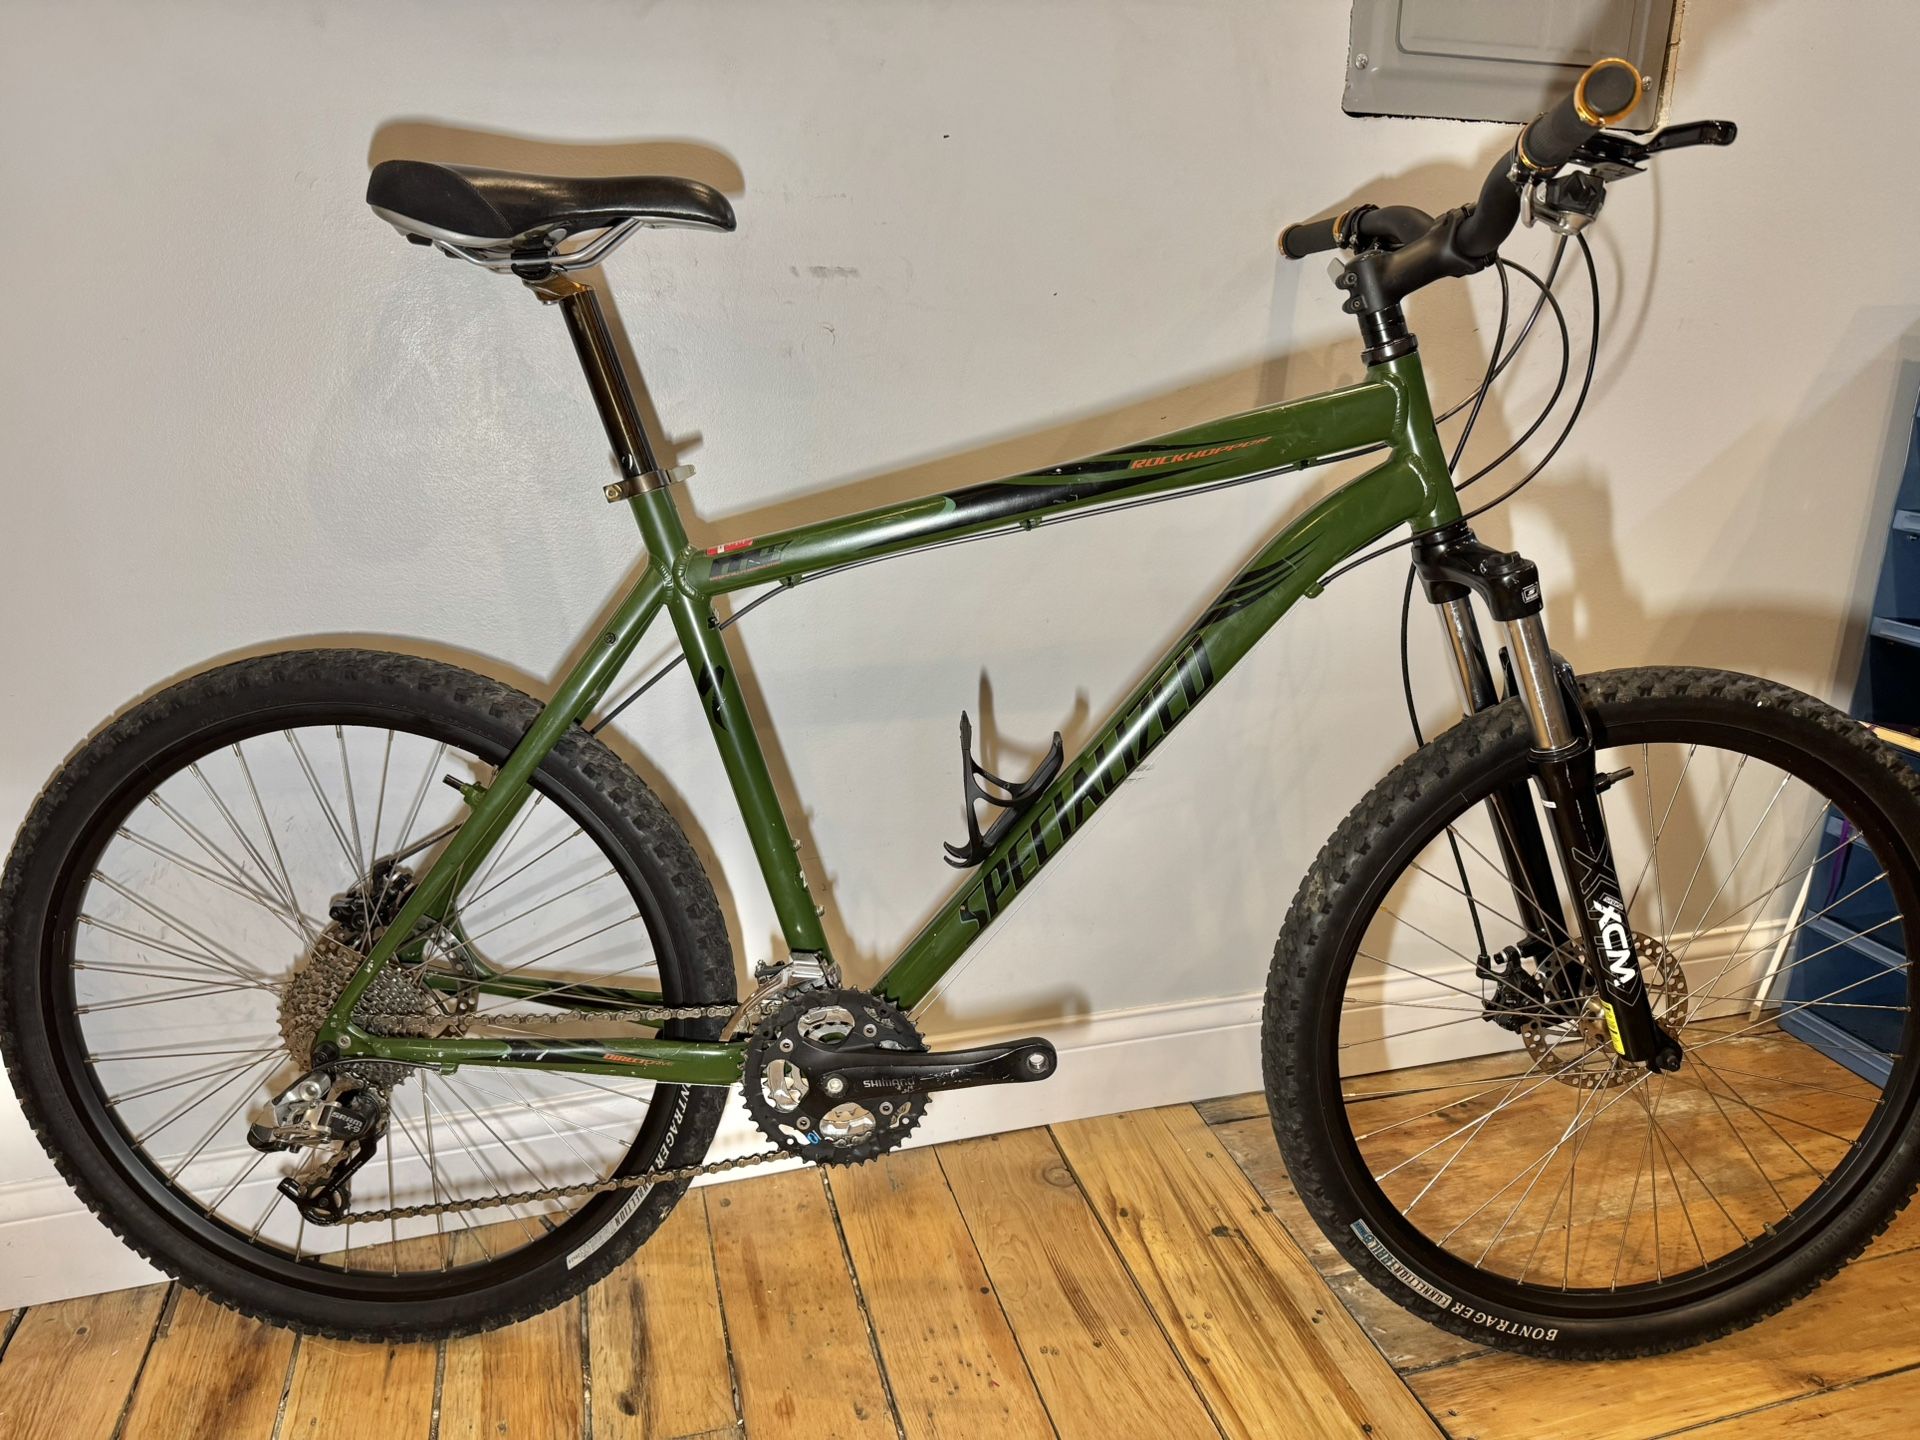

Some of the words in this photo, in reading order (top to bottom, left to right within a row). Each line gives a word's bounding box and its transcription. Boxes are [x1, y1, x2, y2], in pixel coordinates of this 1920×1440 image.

[957, 633, 1215, 944] SPECIALIZED
[1593, 899, 1636, 988] XCM
[331, 1111, 363, 1127] SRAM
[655, 1084, 691, 1169] NTRAGER
[1451, 1302, 1559, 1341] BONTRAGER
